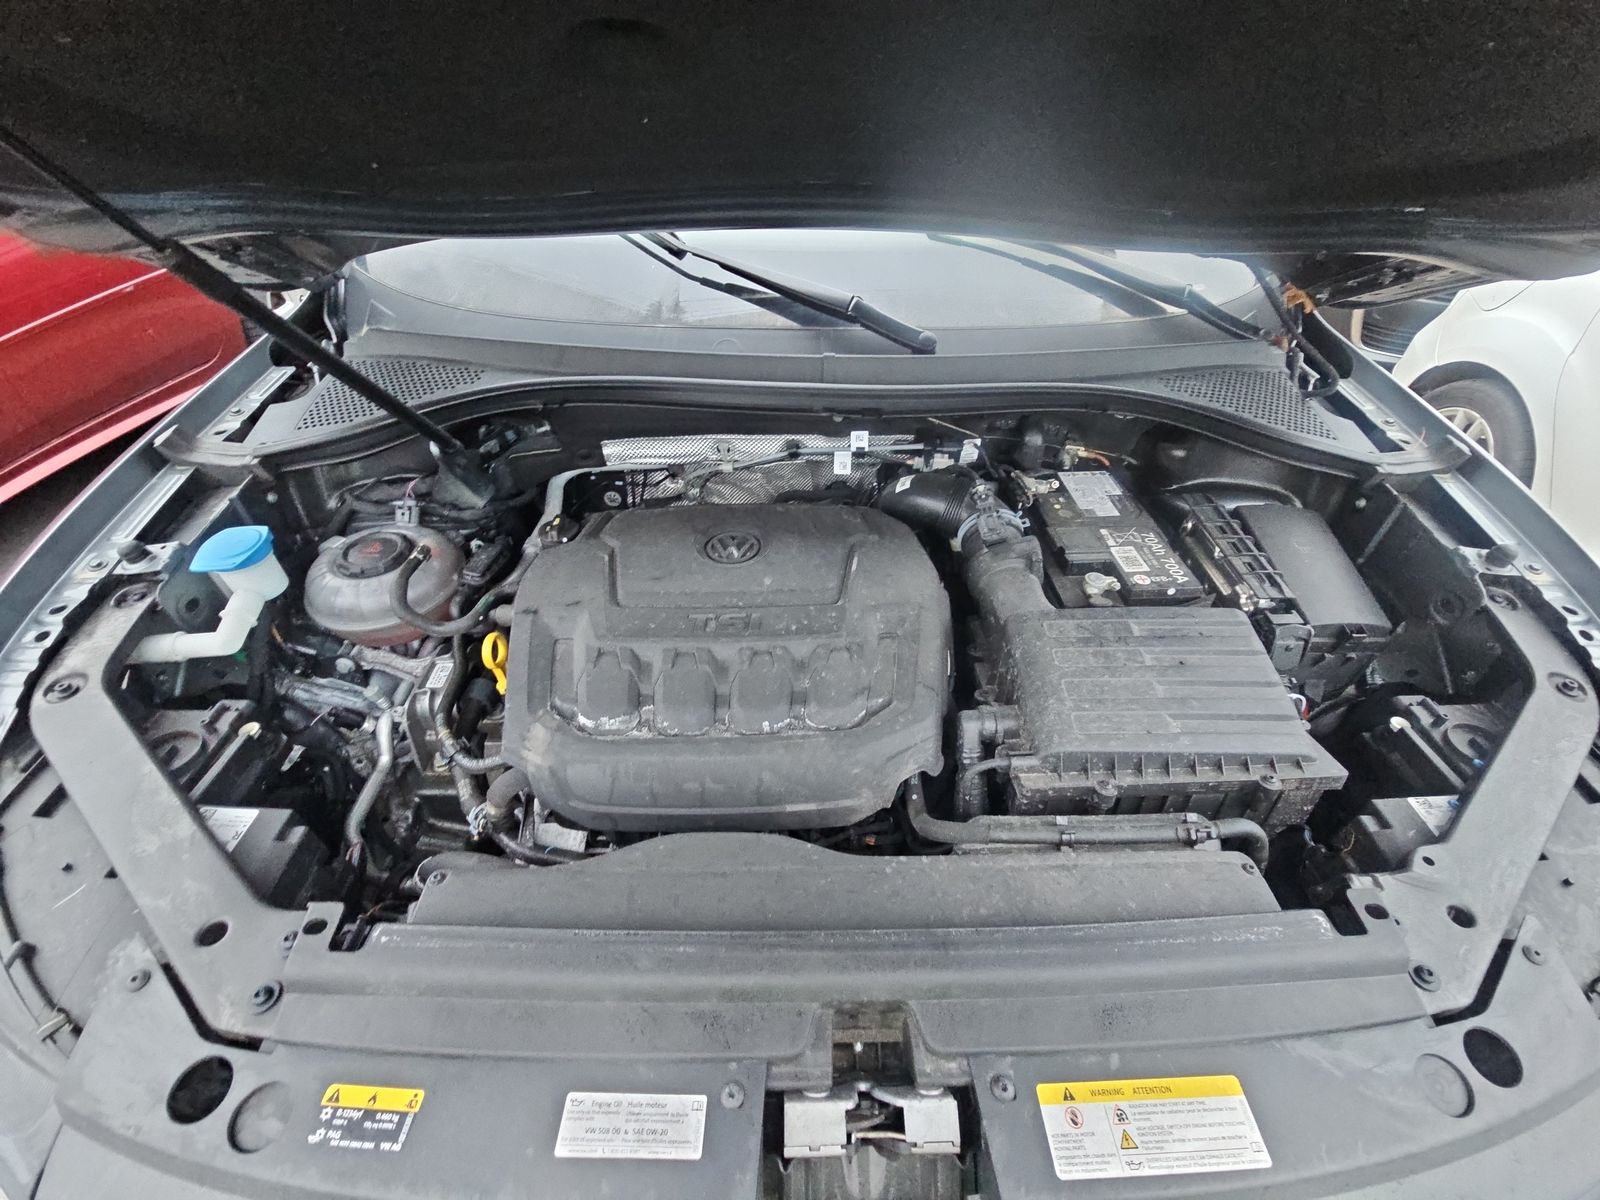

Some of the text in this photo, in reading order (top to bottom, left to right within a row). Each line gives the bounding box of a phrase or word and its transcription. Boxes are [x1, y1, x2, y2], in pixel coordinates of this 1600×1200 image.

[1141, 532, 1167, 556] 70Ah
[1161, 557, 1190, 584] 700A
[687, 612, 760, 633] TSI
[1089, 1085, 1172, 1097] WARNING ATTENTION
[591, 1100, 612, 1110] Engine
[644, 1101, 668, 1109] moteur
[585, 1127, 597, 1135] VW
[632, 1127, 645, 1135] SAE
